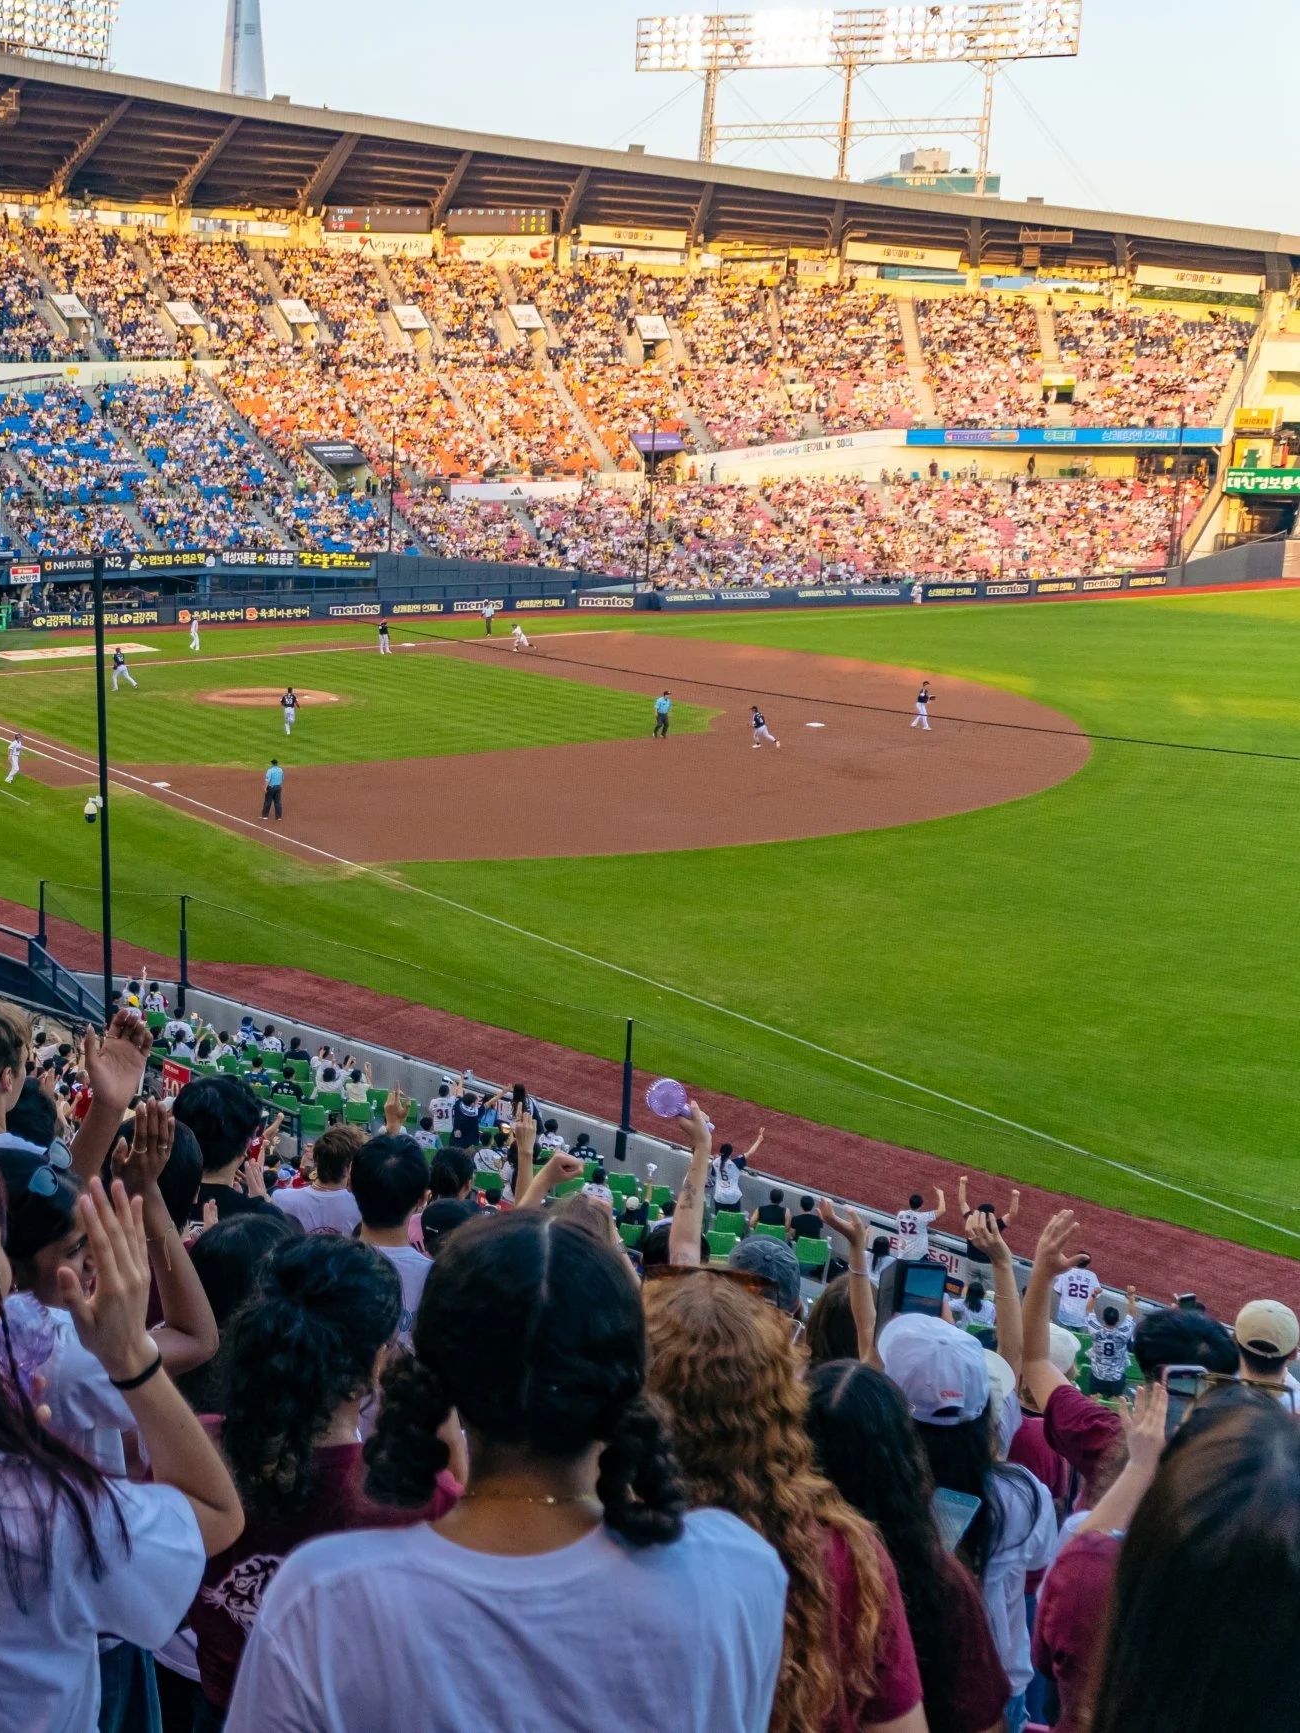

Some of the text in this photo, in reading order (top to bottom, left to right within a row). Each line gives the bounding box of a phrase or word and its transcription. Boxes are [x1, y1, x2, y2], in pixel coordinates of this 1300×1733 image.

[1145, 430, 1176, 441] 언제나
[140, 553, 206, 566] 수협보험 수협은행
[222, 552, 256, 565] 태성자동문
[299, 552, 356, 569] 장수돌침대
[53, 559, 94, 571] NH투자증
[986, 584, 1029, 595] mentos
[1083, 577, 1122, 590] mentos
[721, 591, 770, 600] mentos
[851, 587, 900, 596] mentos
[422, 604, 443, 612] 언제나
[579, 596, 634, 608] mentos
[329, 604, 381, 616] mentos
[46, 614, 71, 627] 금강주택
[132, 611, 157, 624] 금강주택
[436, 1108, 449, 1120] 31
[900, 1221, 917, 1235] 52
[1068, 1283, 1089, 1299] 25
[1103, 1342, 1115, 1357] 8
